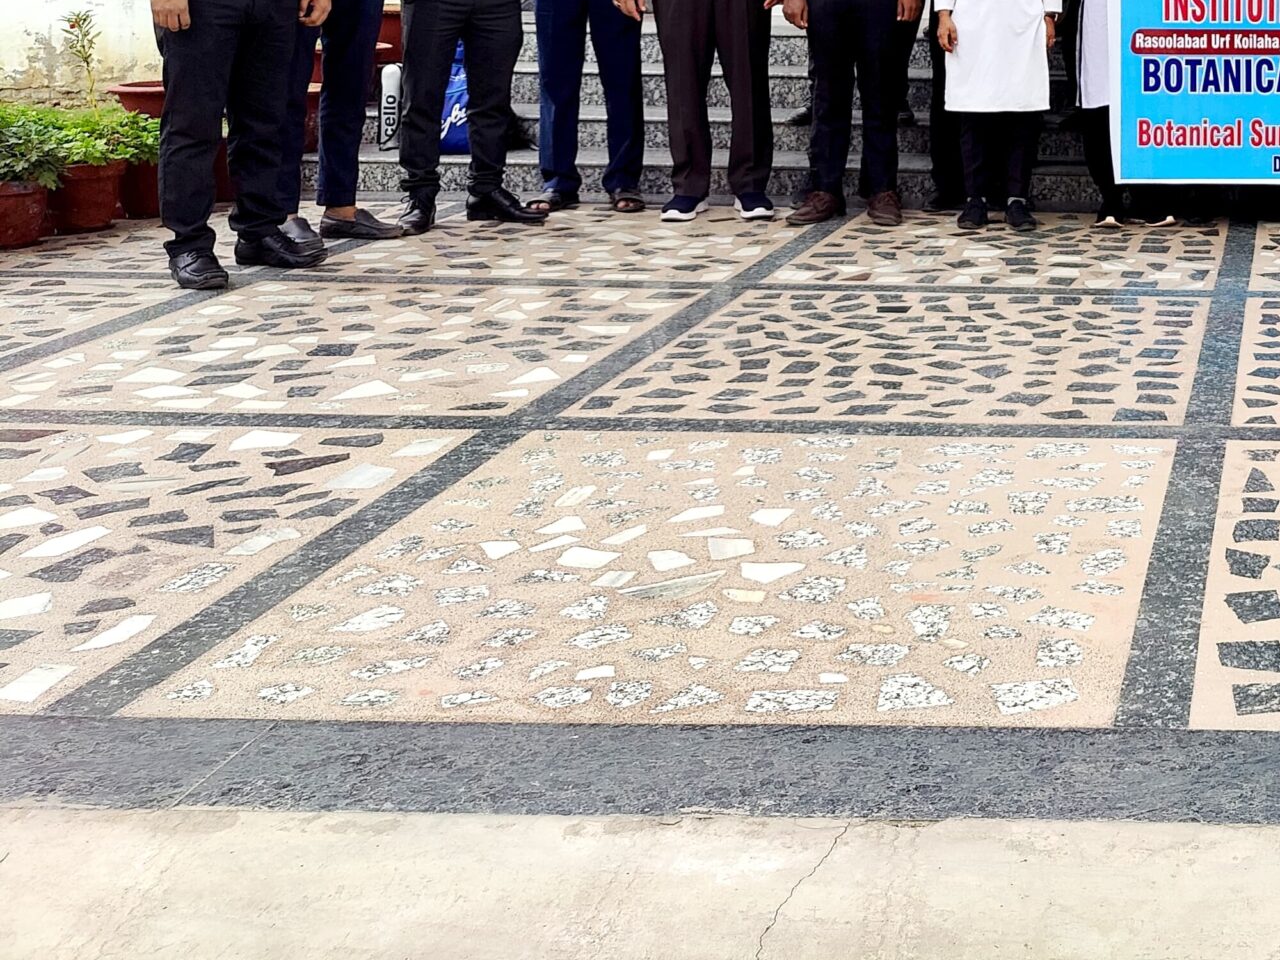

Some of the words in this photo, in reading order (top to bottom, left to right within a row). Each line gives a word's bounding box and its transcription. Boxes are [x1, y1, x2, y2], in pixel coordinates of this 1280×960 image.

[1135, 33, 1207, 49] Rasoolabad
[1211, 33, 1230, 49] Urf
[382, 94, 397, 137] cello
[1138, 119, 1242, 146] Botanical
